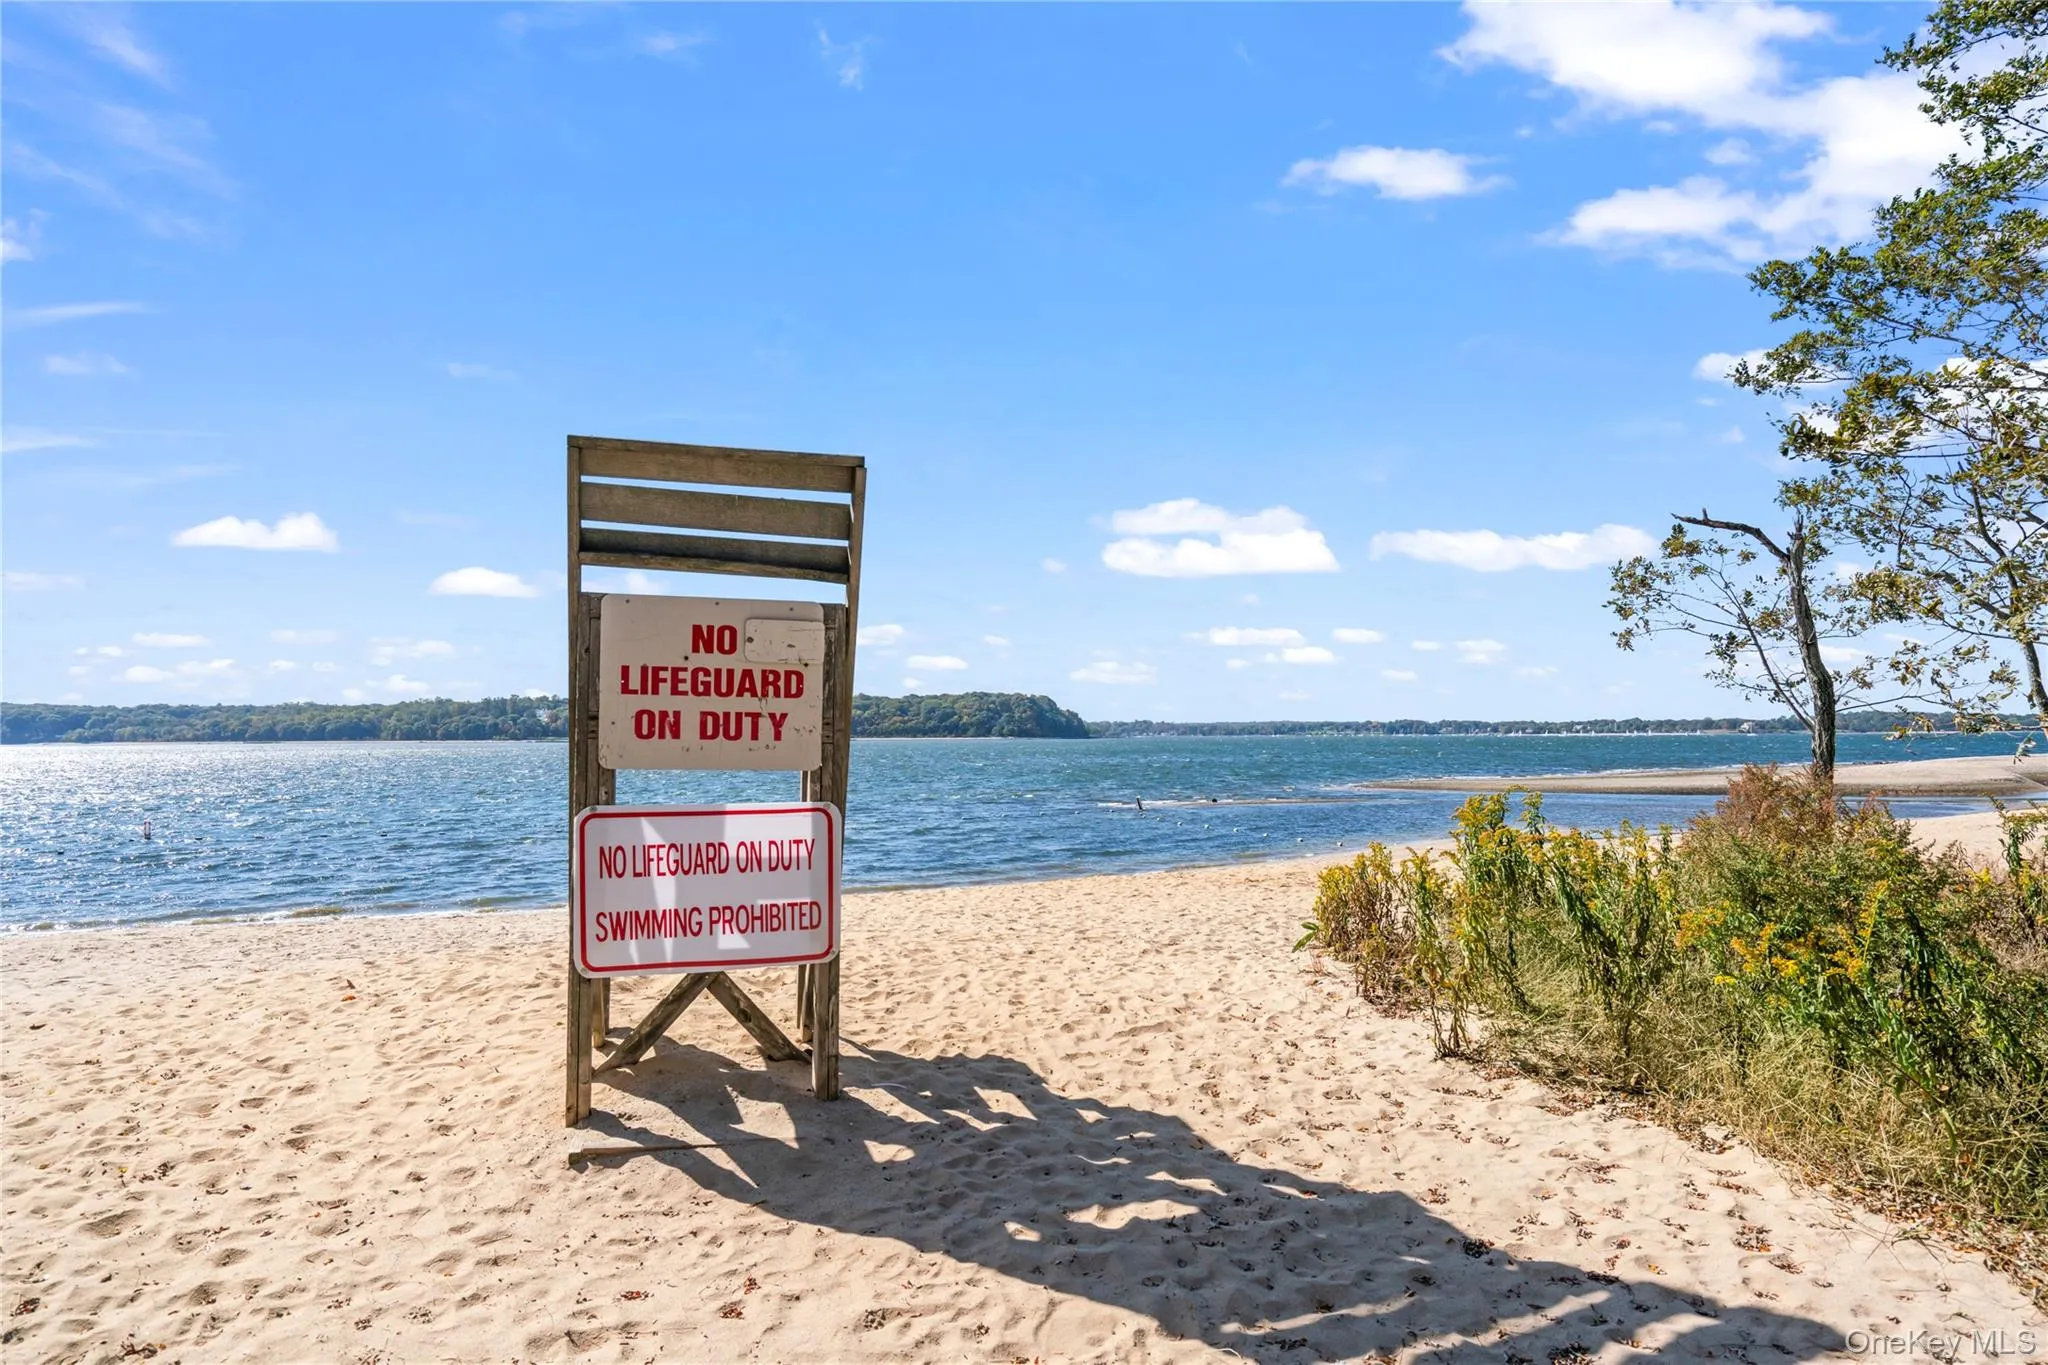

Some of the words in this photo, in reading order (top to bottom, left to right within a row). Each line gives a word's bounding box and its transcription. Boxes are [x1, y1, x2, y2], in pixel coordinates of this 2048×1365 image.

[691, 624, 738, 656] NO
[619, 665, 805, 699] LIFEGUARD
[634, 709, 682, 741] ON
[698, 710, 789, 743] DUTY
[598, 844, 627, 879] NO
[631, 842, 730, 878] LIFEGUARD
[736, 841, 763, 873] ON
[768, 838, 815, 872] DUTY
[595, 907, 703, 942] SWIMMING
[708, 901, 822, 935] PROHIBITED
